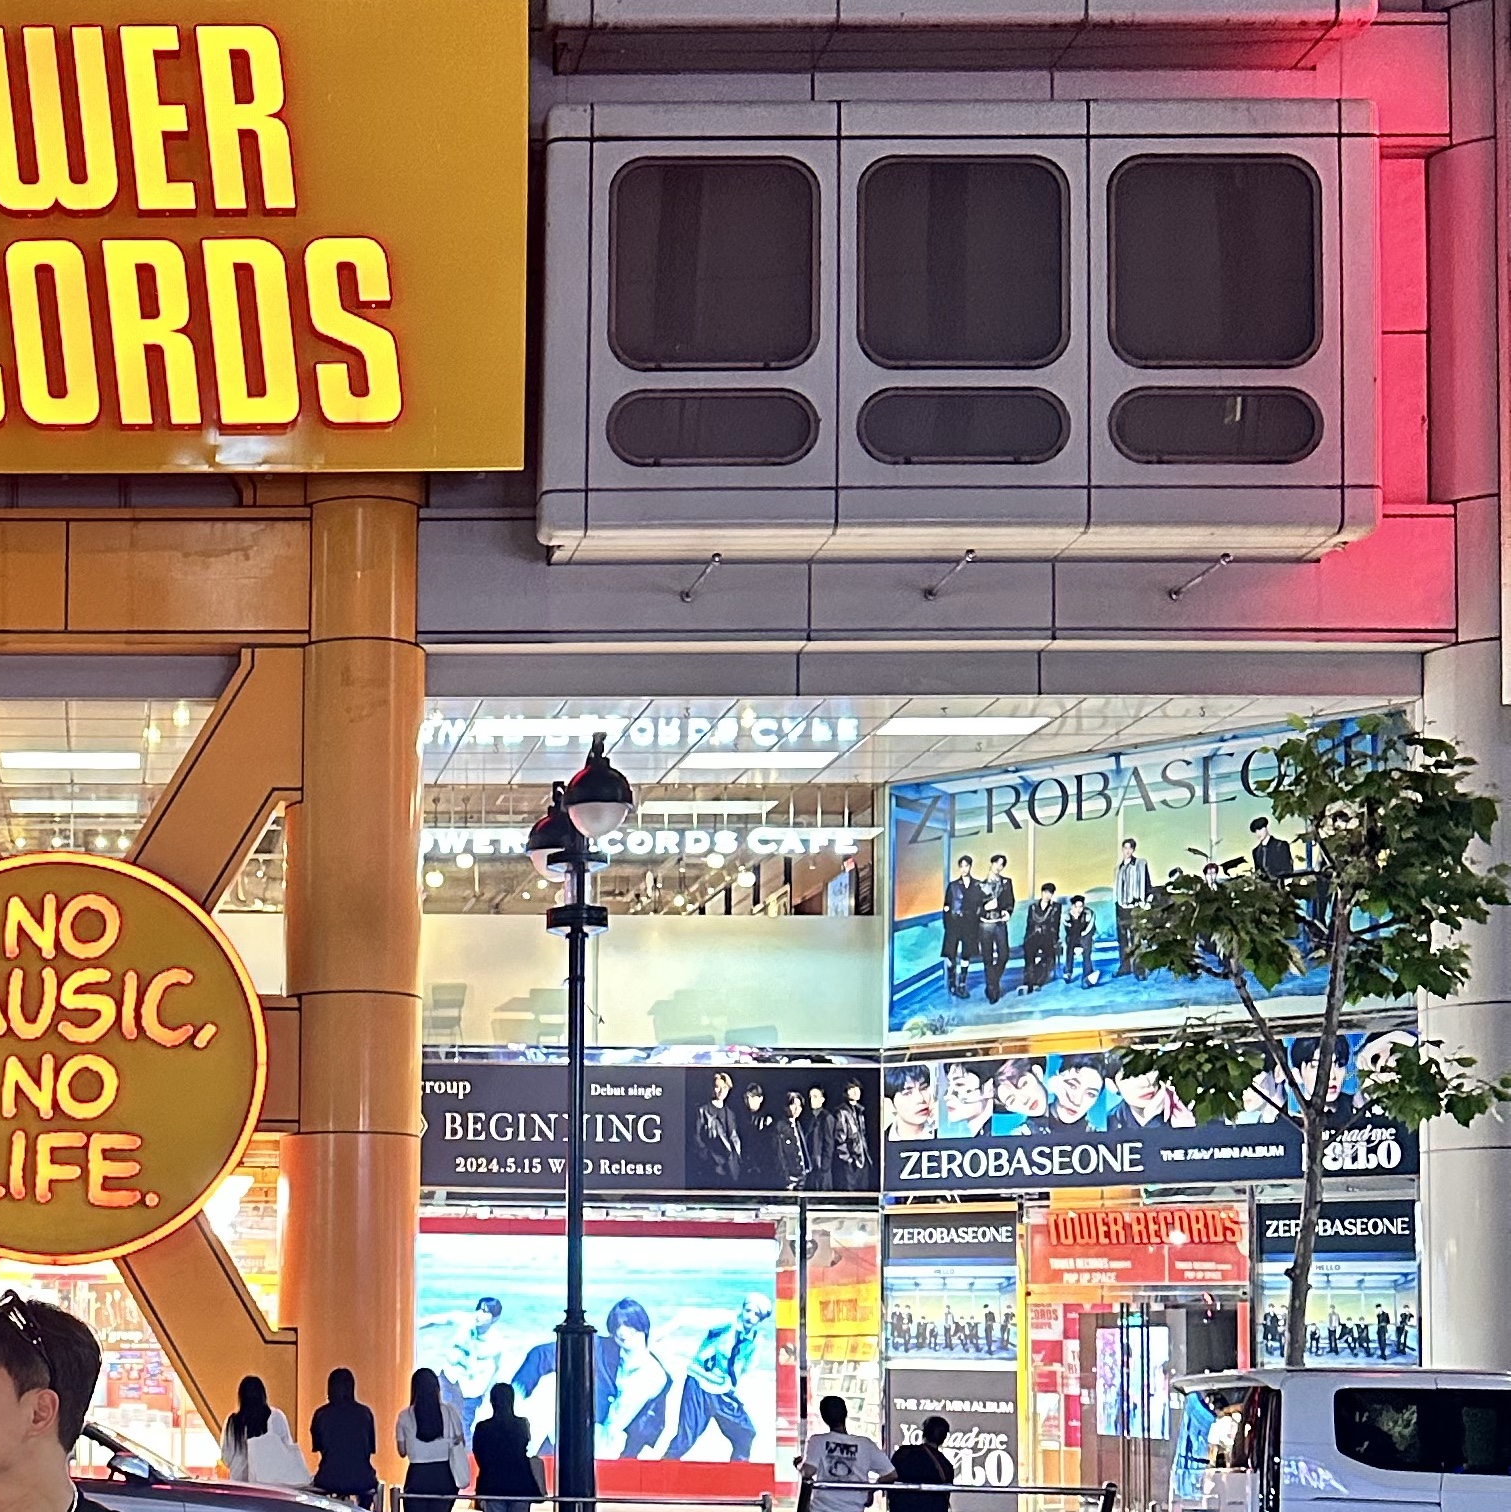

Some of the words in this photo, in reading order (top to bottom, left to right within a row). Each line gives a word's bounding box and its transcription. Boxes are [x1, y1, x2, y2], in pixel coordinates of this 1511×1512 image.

[908, 748, 1286, 844] ZEROBASEO
[421, 828, 527, 856] OWER
[585, 828, 738, 856] CORDS
[746, 826, 860, 856] CAFE
[4, 892, 122, 960] NO
[0, 1052, 119, 1121] NO
[421, 1080, 472, 1100] roup
[590, 1083, 626, 1097] Debut
[628, 1084, 663, 1100] single
[455, 1157, 542, 1175] 2024.5.15
[547, 1158, 593, 1175] WD
[599, 1159, 663, 1175] Release
[899, 1142, 1145, 1180] ZEROBASEONE
[1160, 1148, 1185, 1162] THE
[892, 1226, 1013, 1245] ZEROBASEONE
[1047, 1209, 1127, 1246] TOWER
[1131, 1208, 1243, 1246] RECORDS
[1265, 1216, 1410, 1238] ZERBASEONE
[894, 1398, 918, 1412] THE
[900, 1423, 925, 1447] Yo
